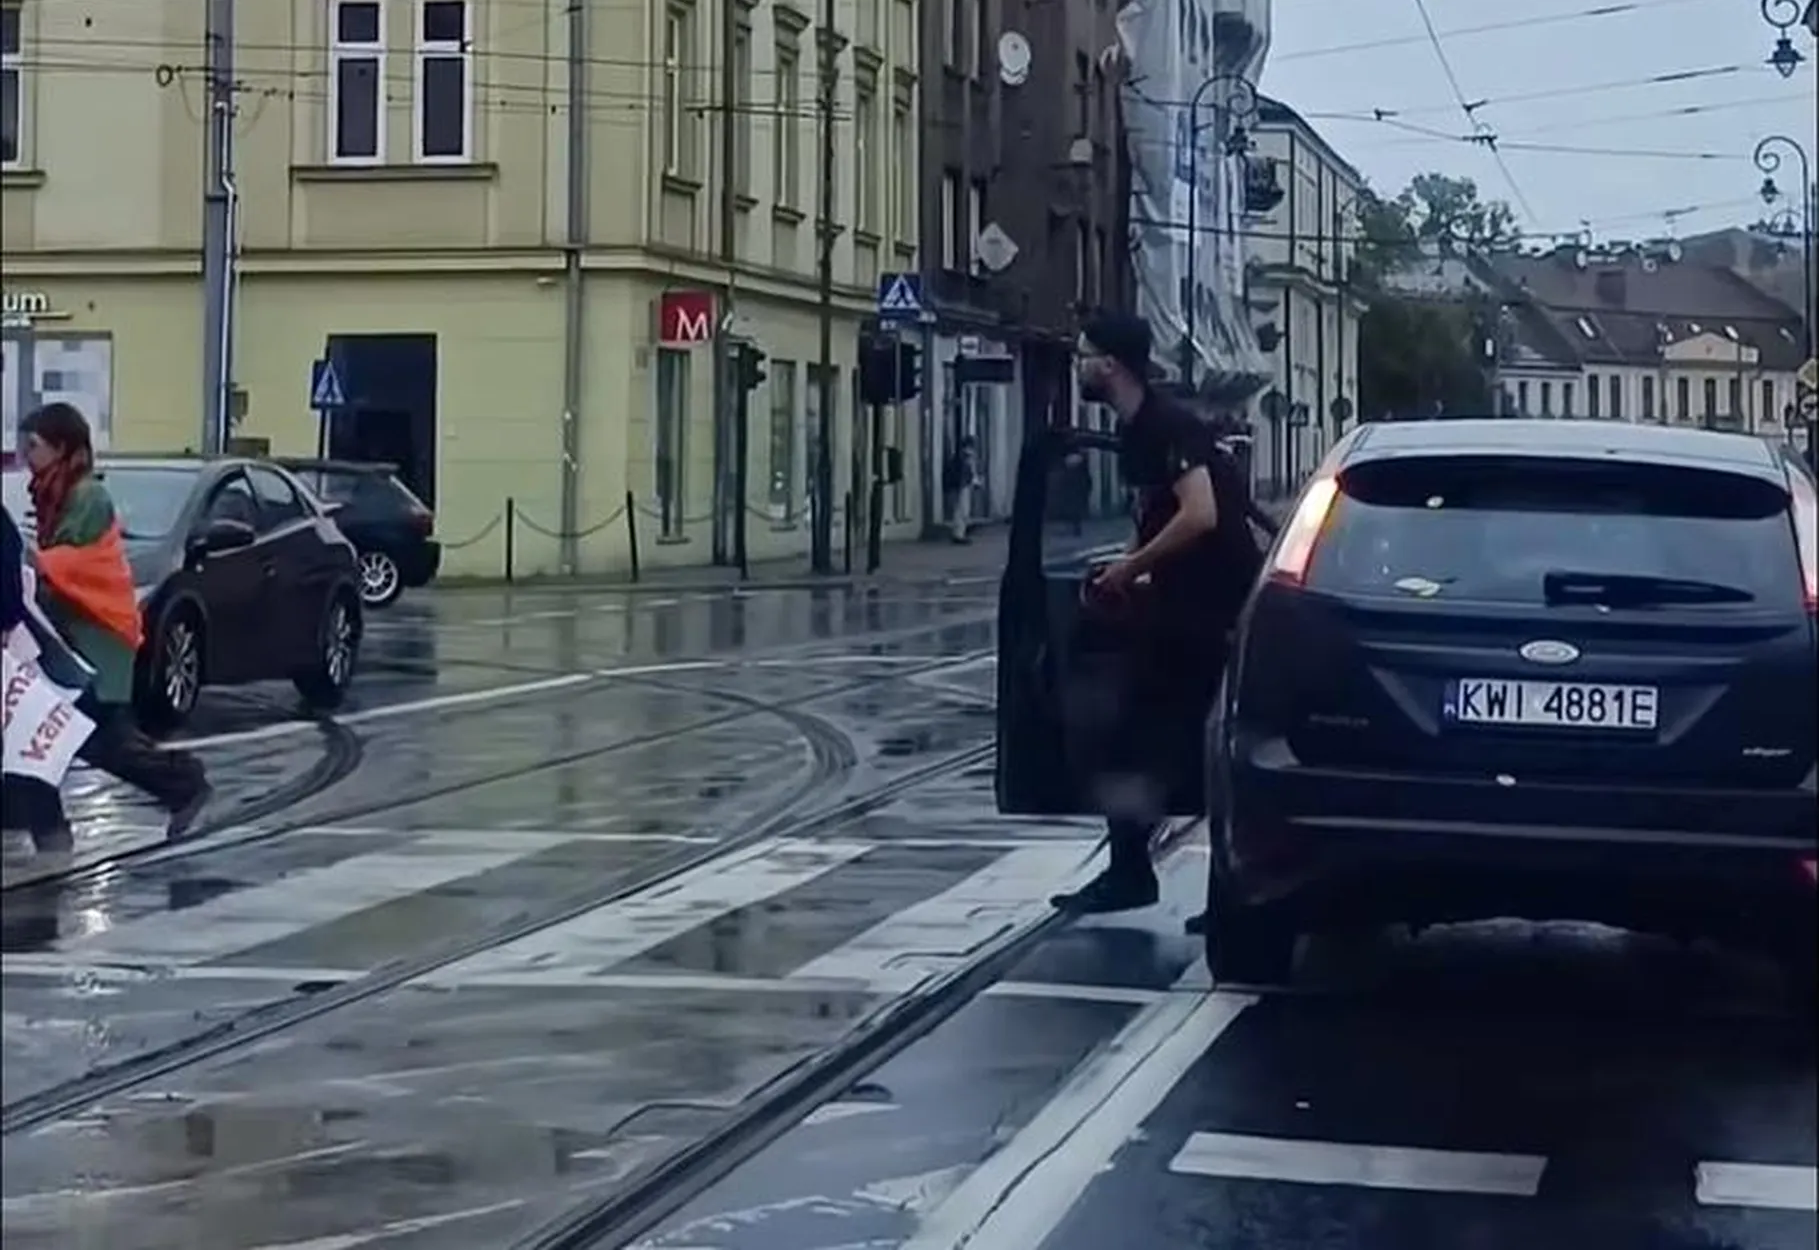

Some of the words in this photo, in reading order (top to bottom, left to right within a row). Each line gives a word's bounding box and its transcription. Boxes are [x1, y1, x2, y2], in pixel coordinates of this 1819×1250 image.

[676, 305, 709, 342] M
[1462, 682, 1523, 720] KWI
[1543, 685, 1654, 726] 4881E
